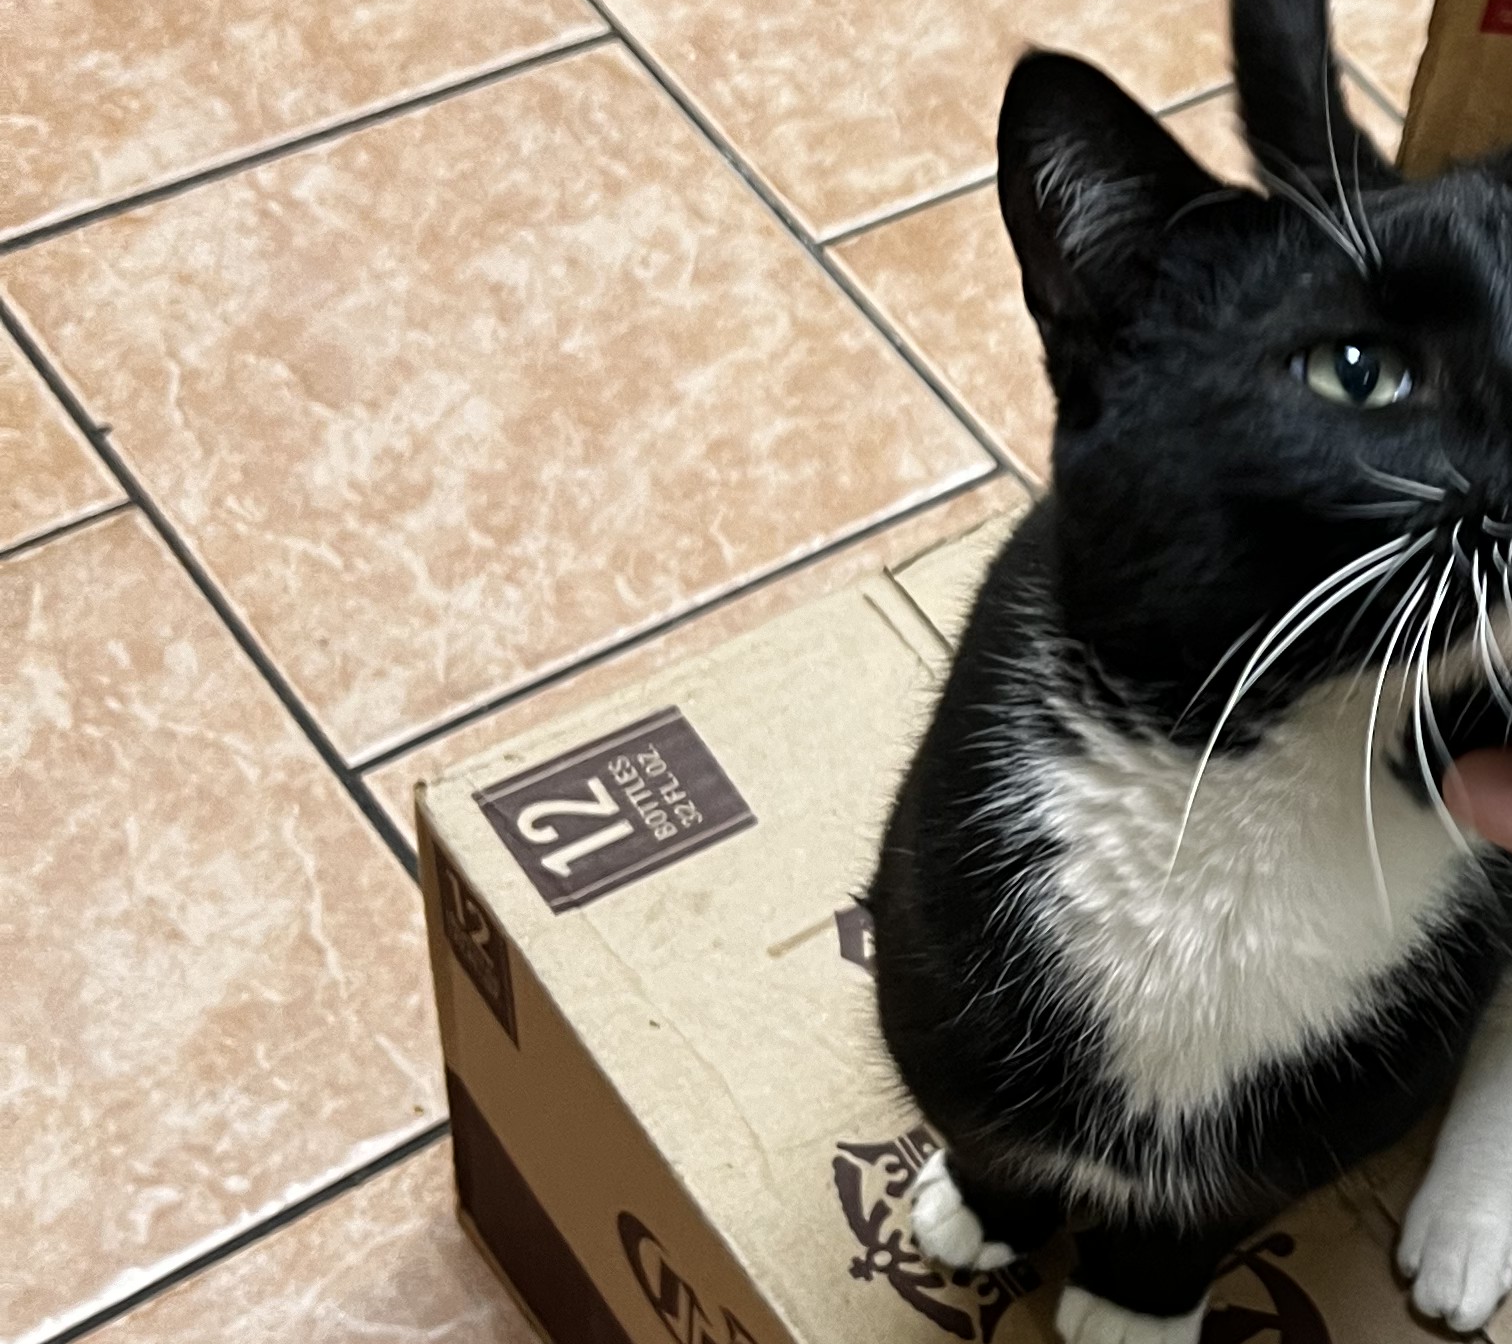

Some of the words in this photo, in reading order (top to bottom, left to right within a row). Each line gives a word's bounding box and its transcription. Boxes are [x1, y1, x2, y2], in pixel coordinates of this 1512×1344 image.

[516, 774, 636, 878] 12
[607, 754, 679, 842] BOTTLES
[673, 799, 704, 829] 32
